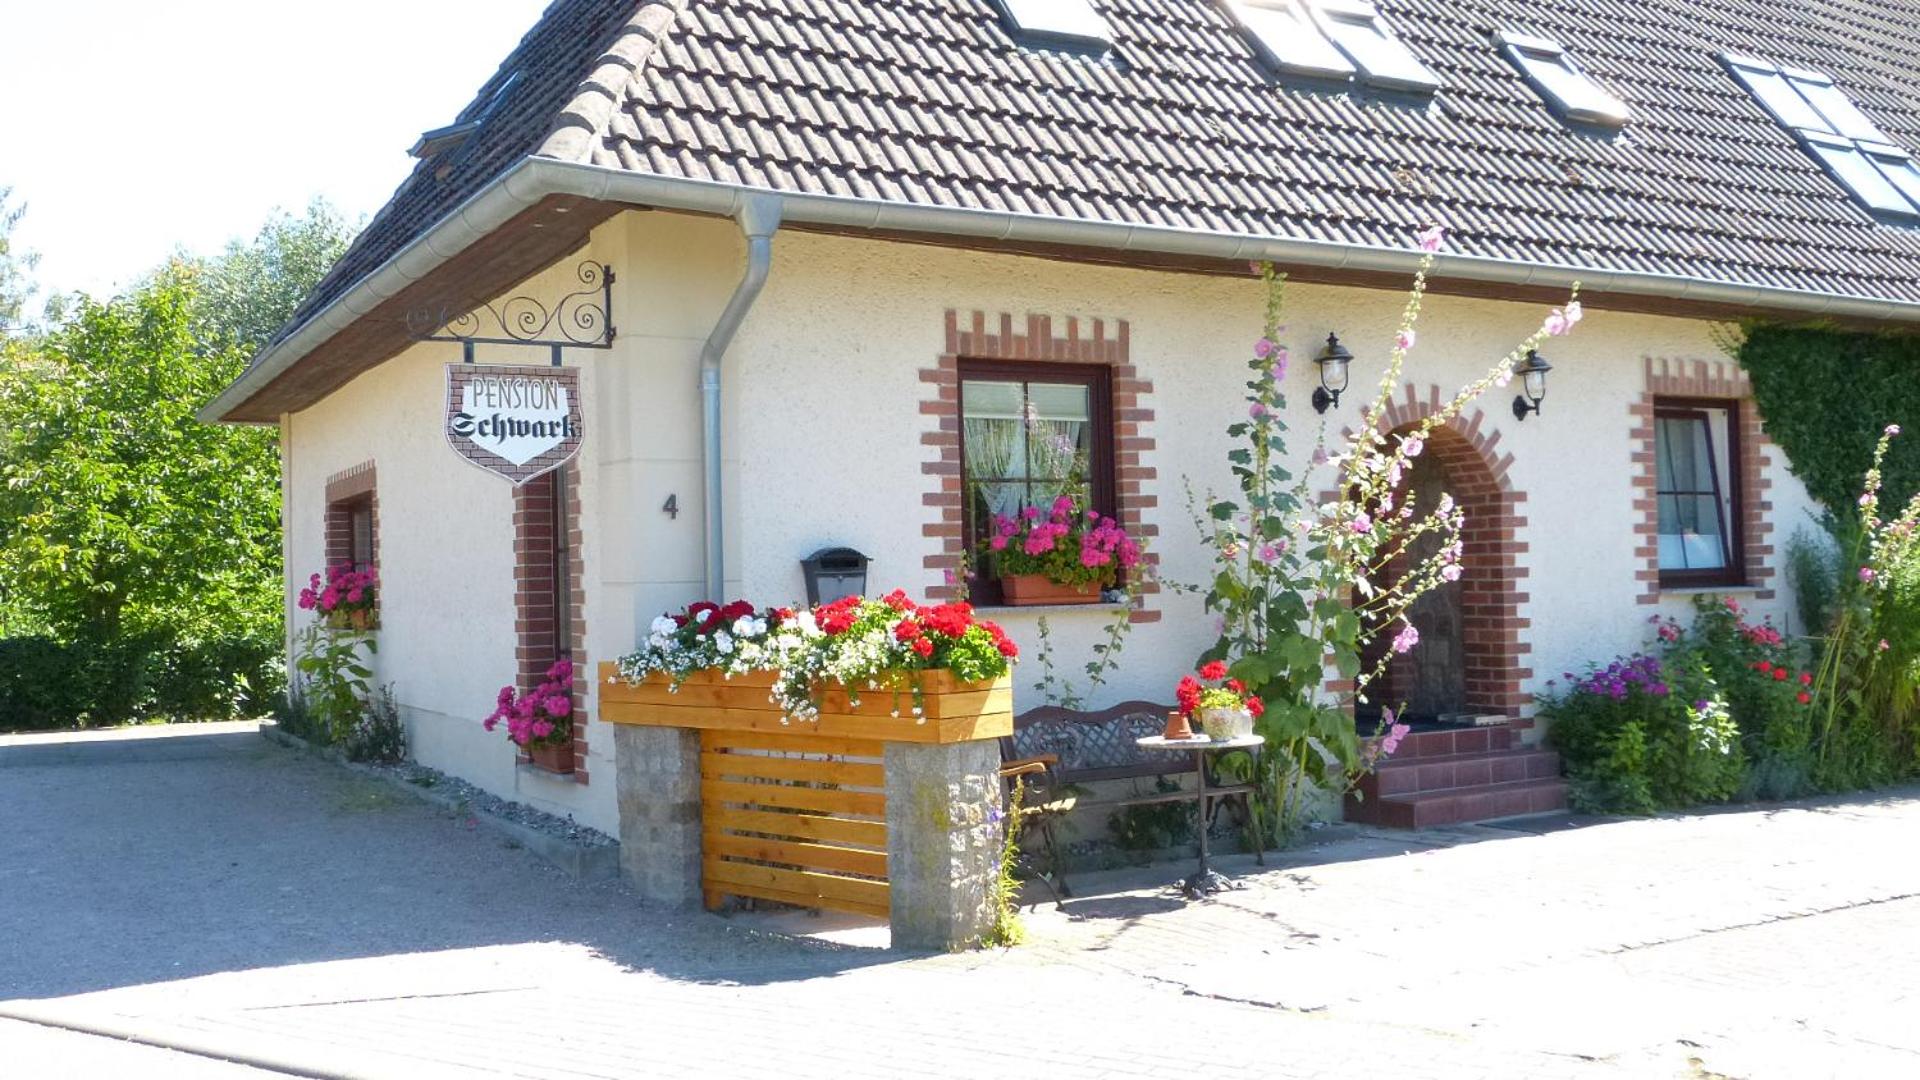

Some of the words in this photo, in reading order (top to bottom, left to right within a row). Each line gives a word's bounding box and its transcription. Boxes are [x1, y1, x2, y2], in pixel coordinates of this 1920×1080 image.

[472, 377, 559, 410] PENSION
[452, 412, 579, 444] Schwark
[662, 493, 679, 520] 4
